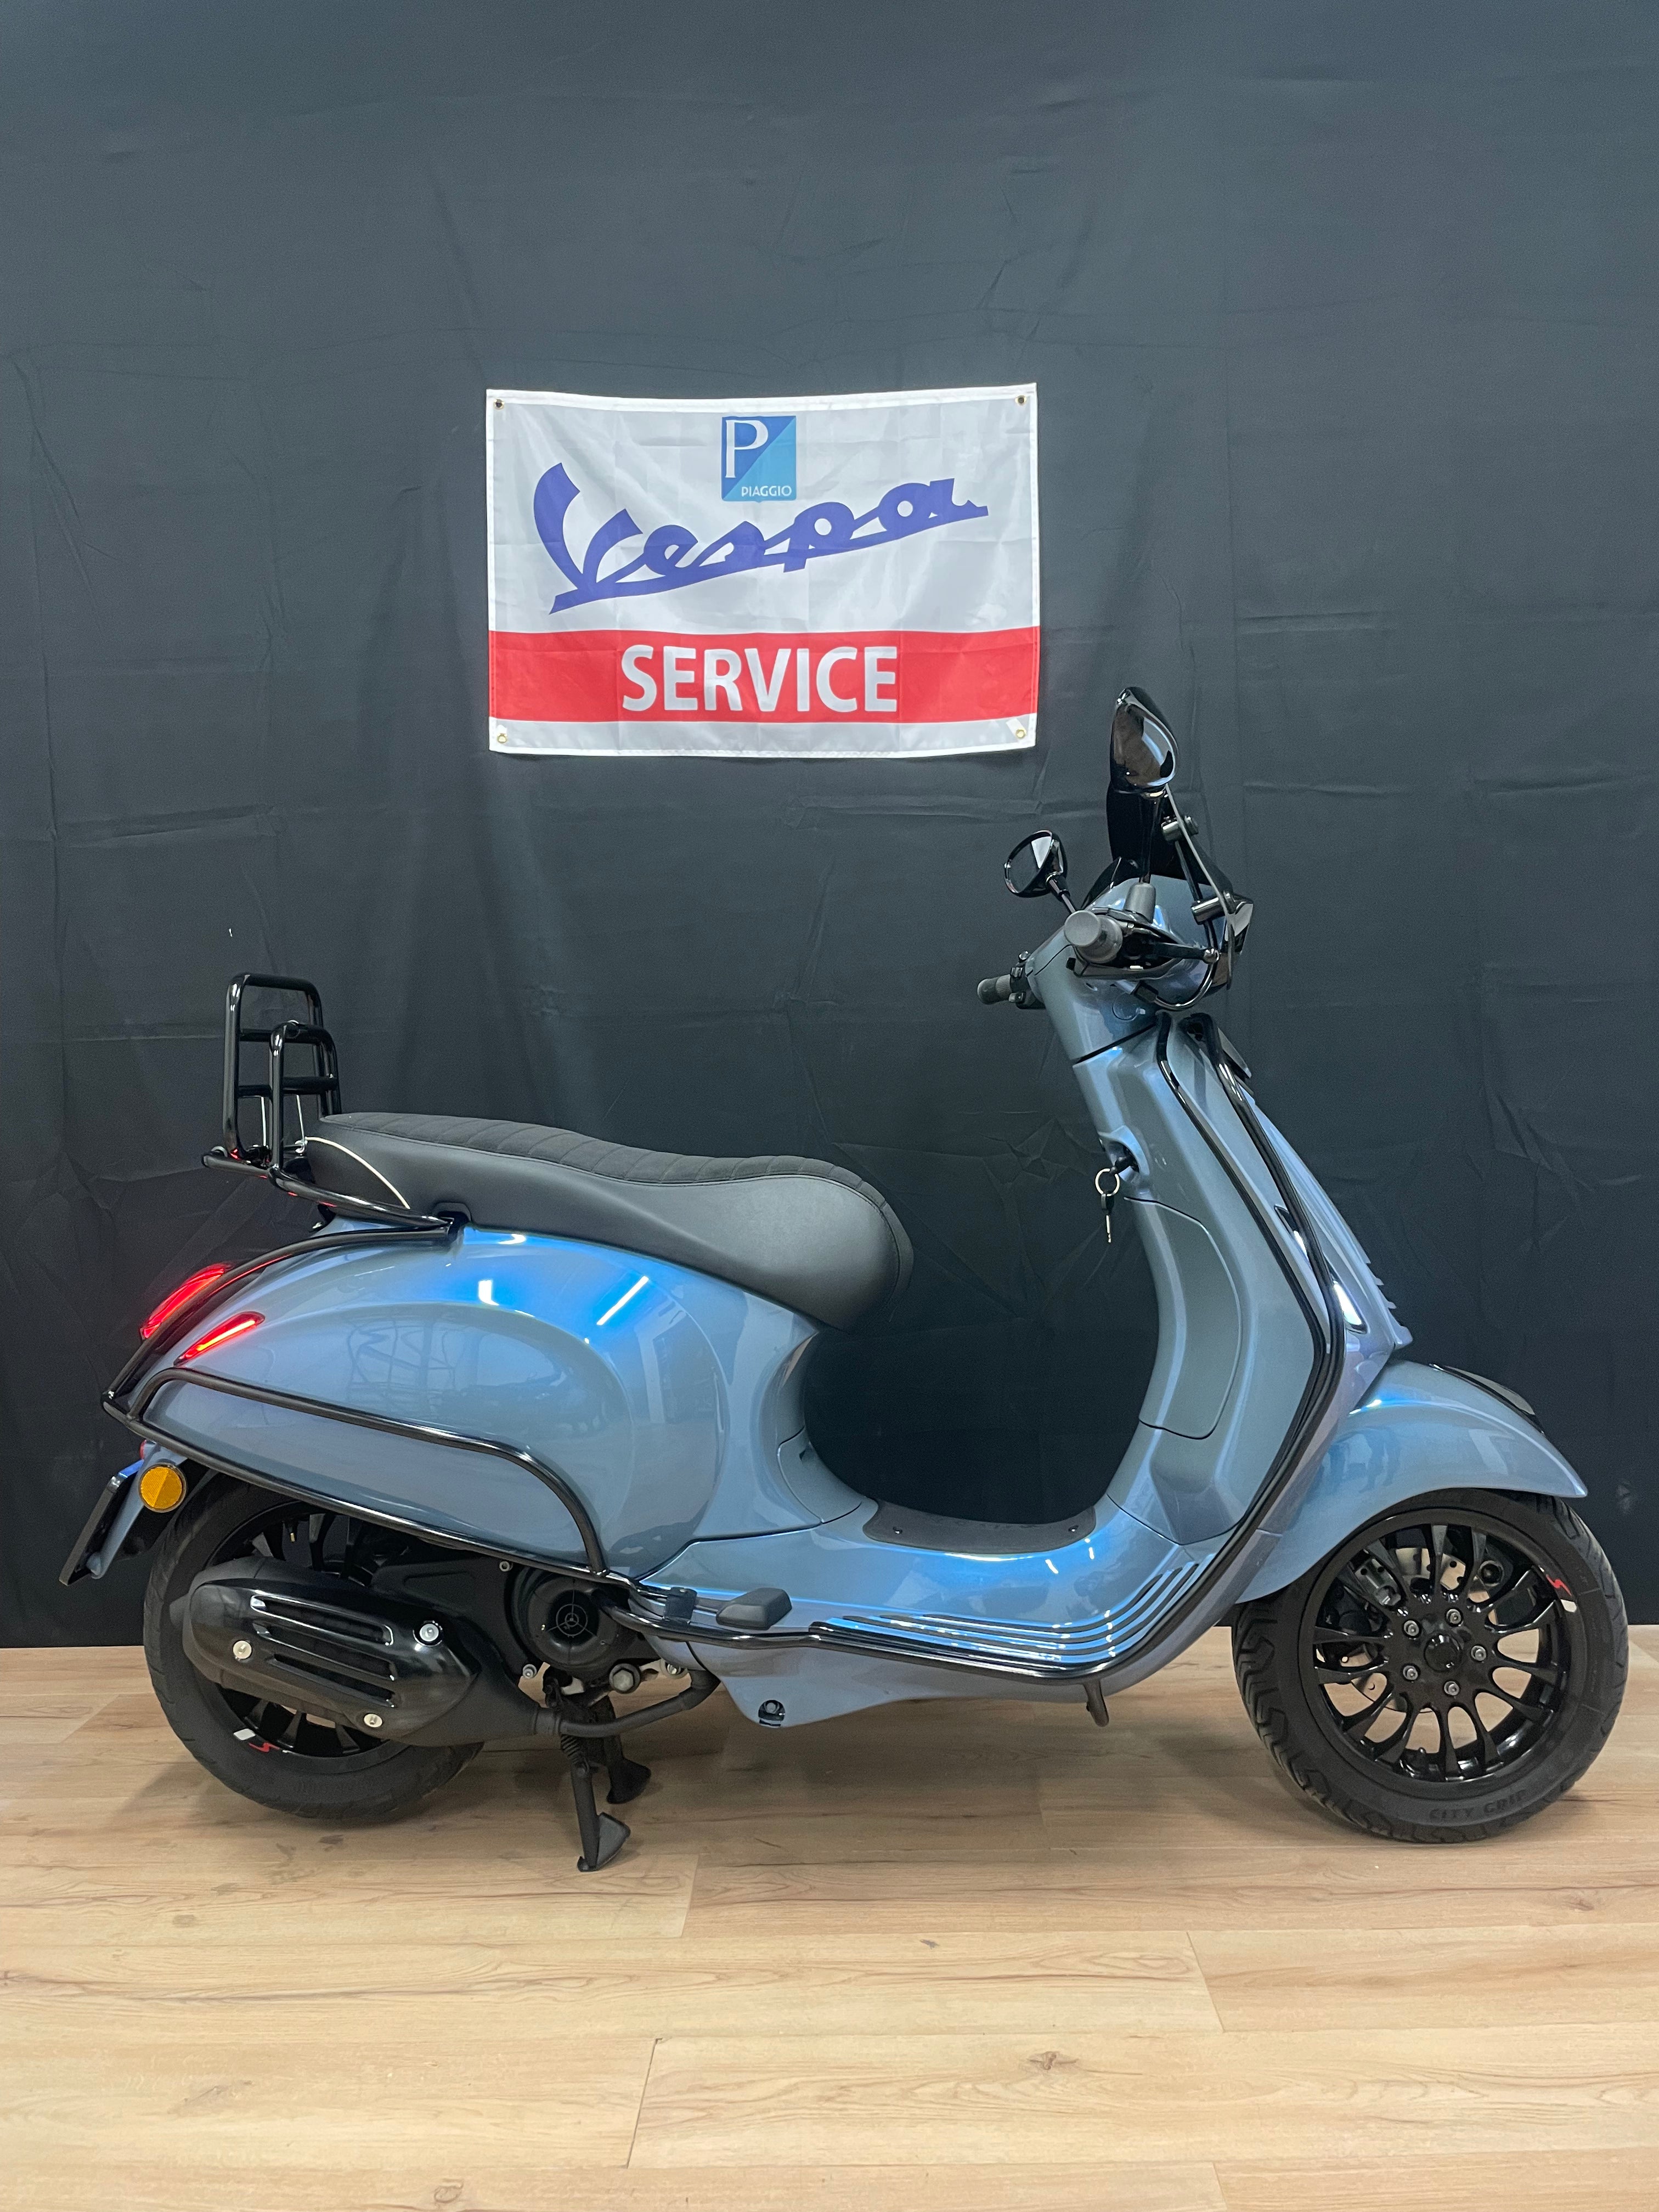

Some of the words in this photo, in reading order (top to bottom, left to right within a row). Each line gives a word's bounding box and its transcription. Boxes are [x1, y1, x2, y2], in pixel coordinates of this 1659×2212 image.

[725, 420, 769, 478] P
[741, 485, 792, 497] PIAGGIO
[534, 462, 988, 614] Vespa
[621, 644, 898, 713] SERVICE
[1429, 1808, 1475, 1819] CITY
[1483, 1789, 1527, 1813] GRIP
